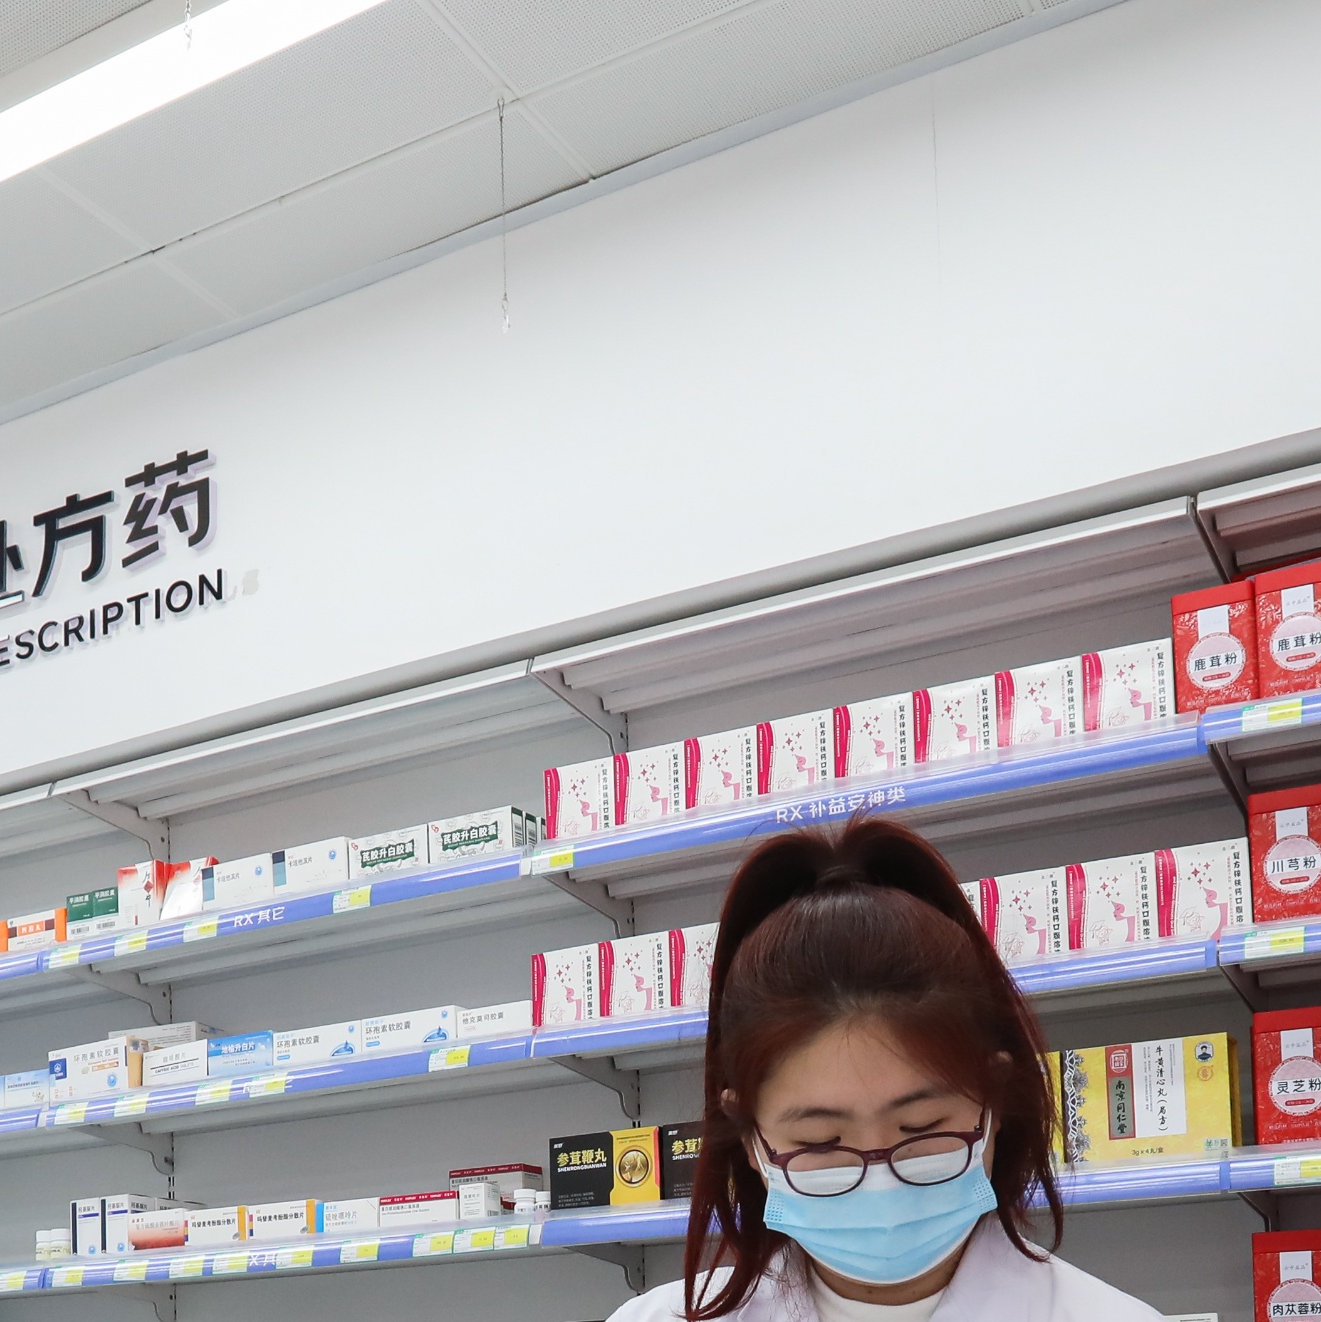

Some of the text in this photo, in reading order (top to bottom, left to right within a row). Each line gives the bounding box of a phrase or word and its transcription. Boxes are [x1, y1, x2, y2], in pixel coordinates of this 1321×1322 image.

[1194, 652, 1238, 672] 鹿茸粉
[776, 786, 907, 825] RX 补益安神类
[443, 823, 499, 846] 芪胶升白胶囊
[362, 840, 415, 862] 芪胶升白胶囊
[1271, 856, 1317, 874] 川芎粉
[233, 905, 286, 928] RX 其它
[365, 1021, 412, 1036] 环孢素软胶囊
[276, 1035, 320, 1050] 环孢素软胶囊
[1276, 1078, 1321, 1095] 灵芝粉
[1114, 1078, 1127, 1135] 南京同仁堂
[557, 1148, 608, 1168] 参茸鞭丸
